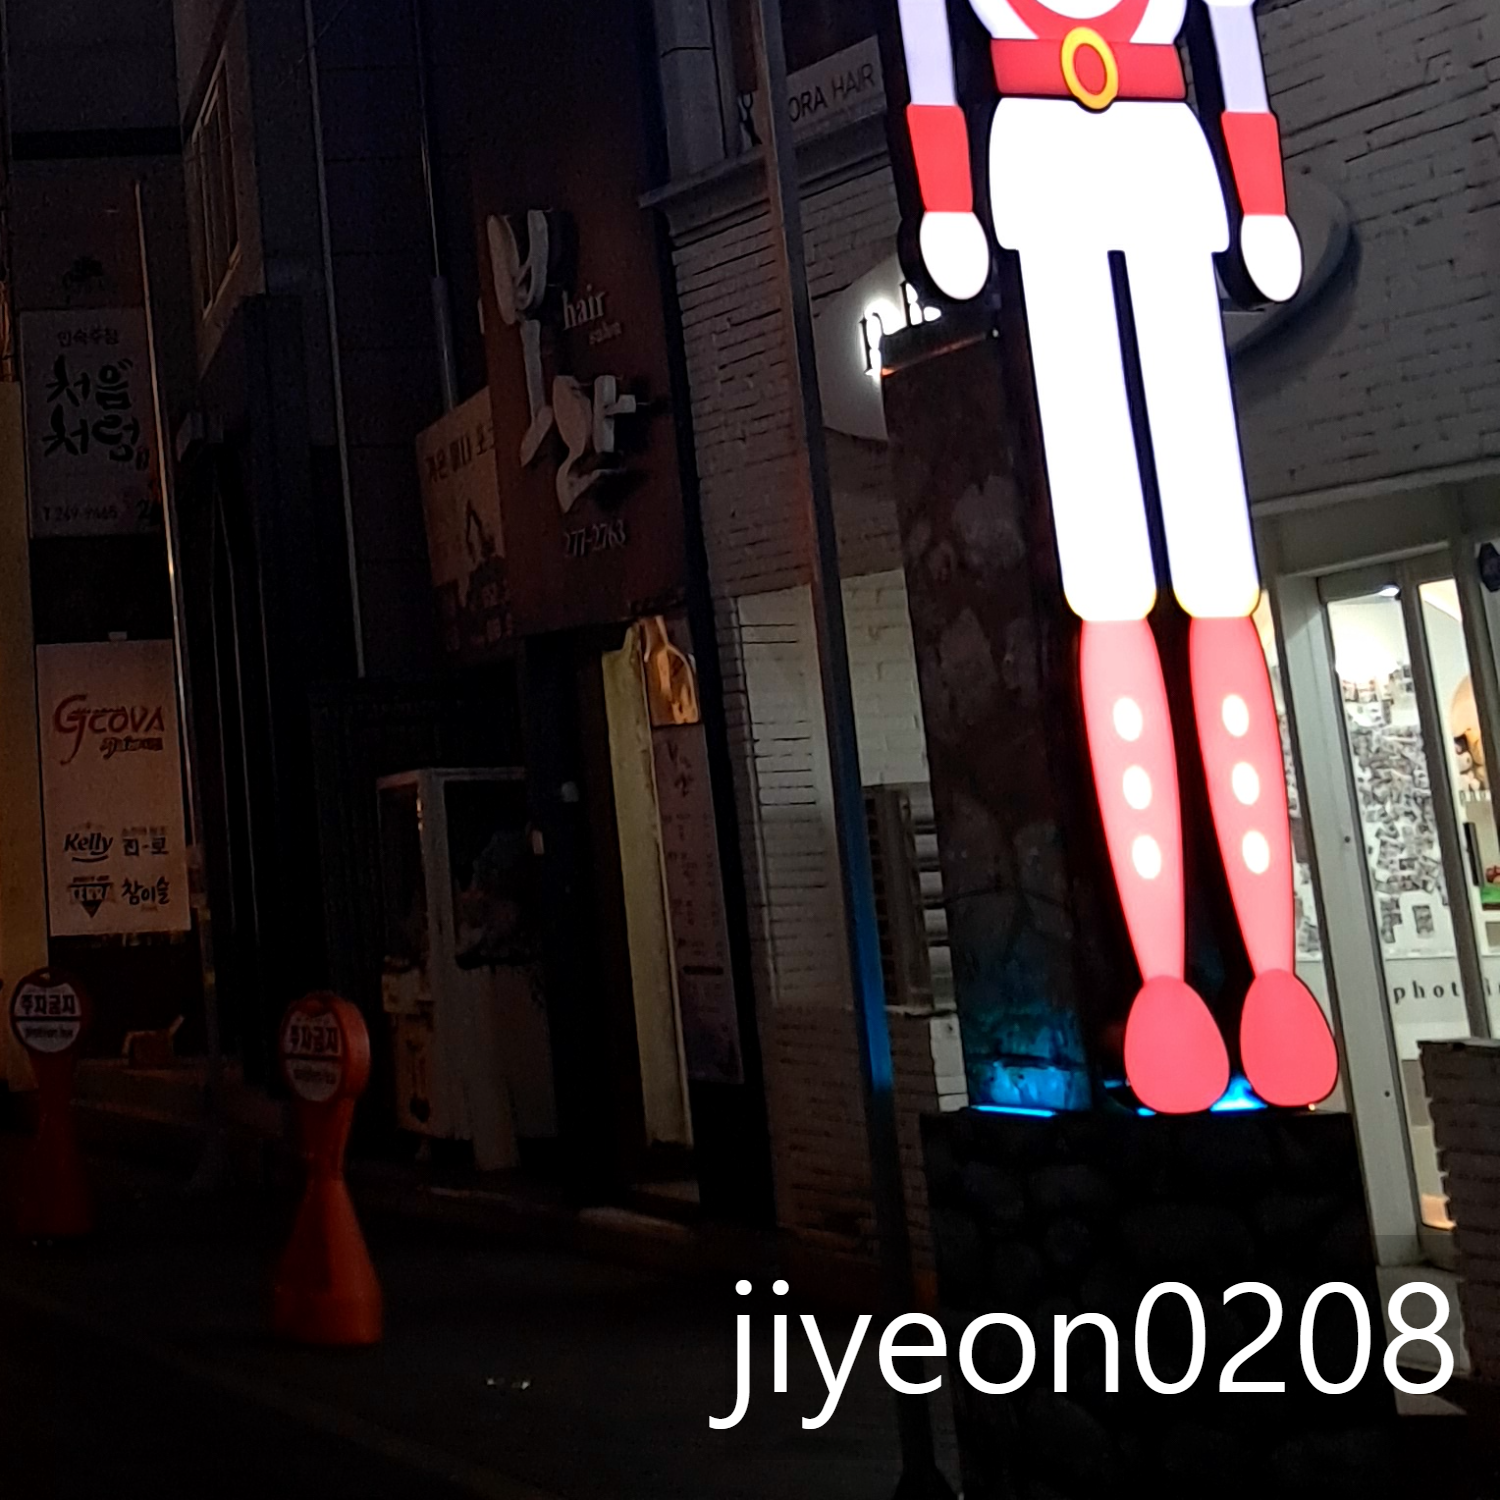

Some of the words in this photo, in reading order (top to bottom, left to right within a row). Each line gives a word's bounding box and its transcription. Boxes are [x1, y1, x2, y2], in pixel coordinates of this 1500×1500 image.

[787, 97, 828, 123] ORA
[831, 63, 875, 102] HAIR
[562, 284, 607, 332] hair
[45, 354, 132, 411] 처음
[41, 404, 140, 462] 처럼
[64, 832, 114, 856] Kelly
[122, 876, 170, 906] 참이슬
